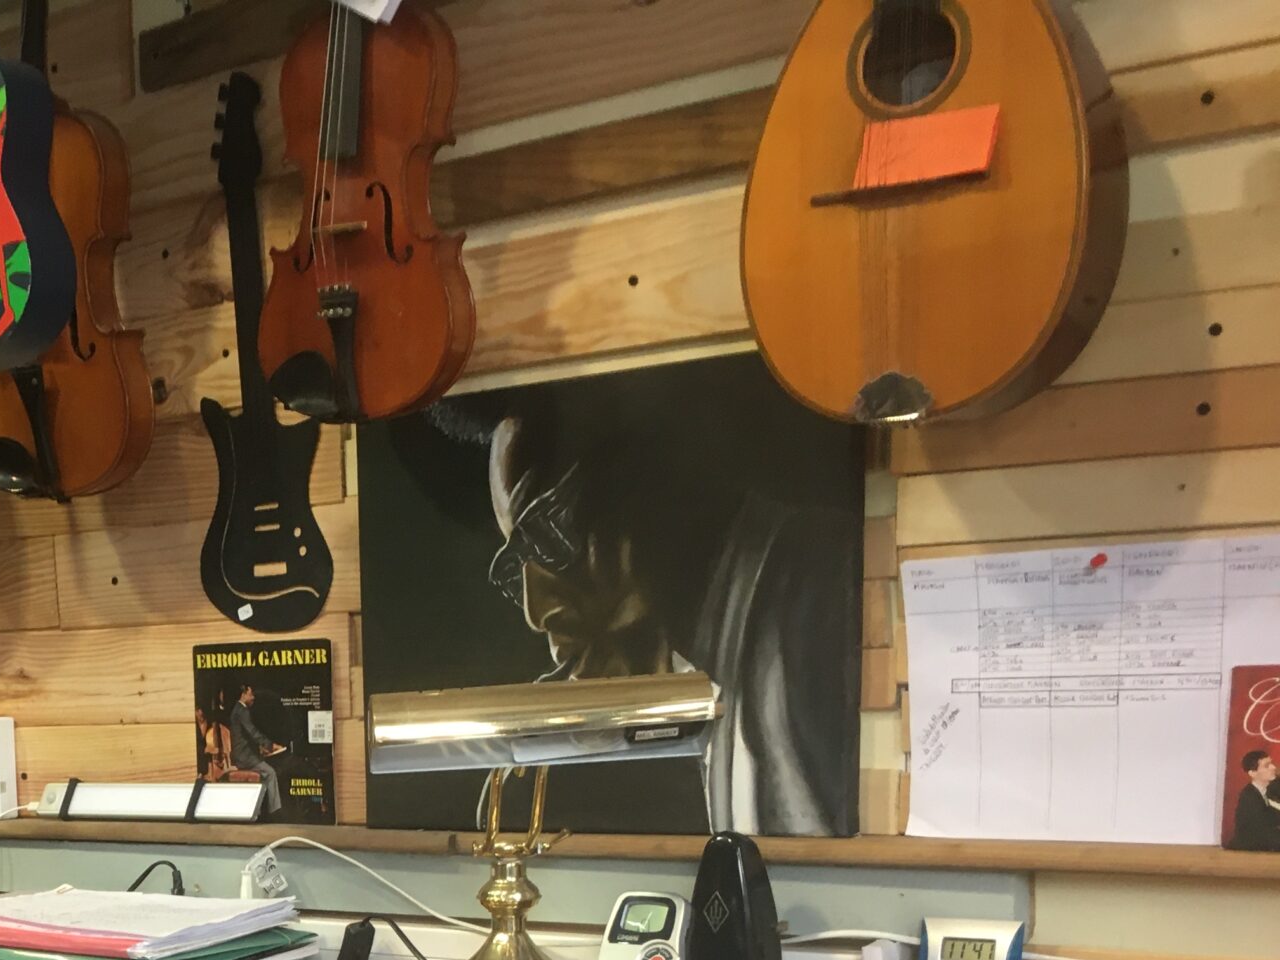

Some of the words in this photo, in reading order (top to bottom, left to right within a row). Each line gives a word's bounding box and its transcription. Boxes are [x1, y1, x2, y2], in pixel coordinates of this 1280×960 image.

[196, 652, 256, 669] ERROLL
[258, 648, 328, 666] GARNER
[289, 787, 323, 796] GARNER
